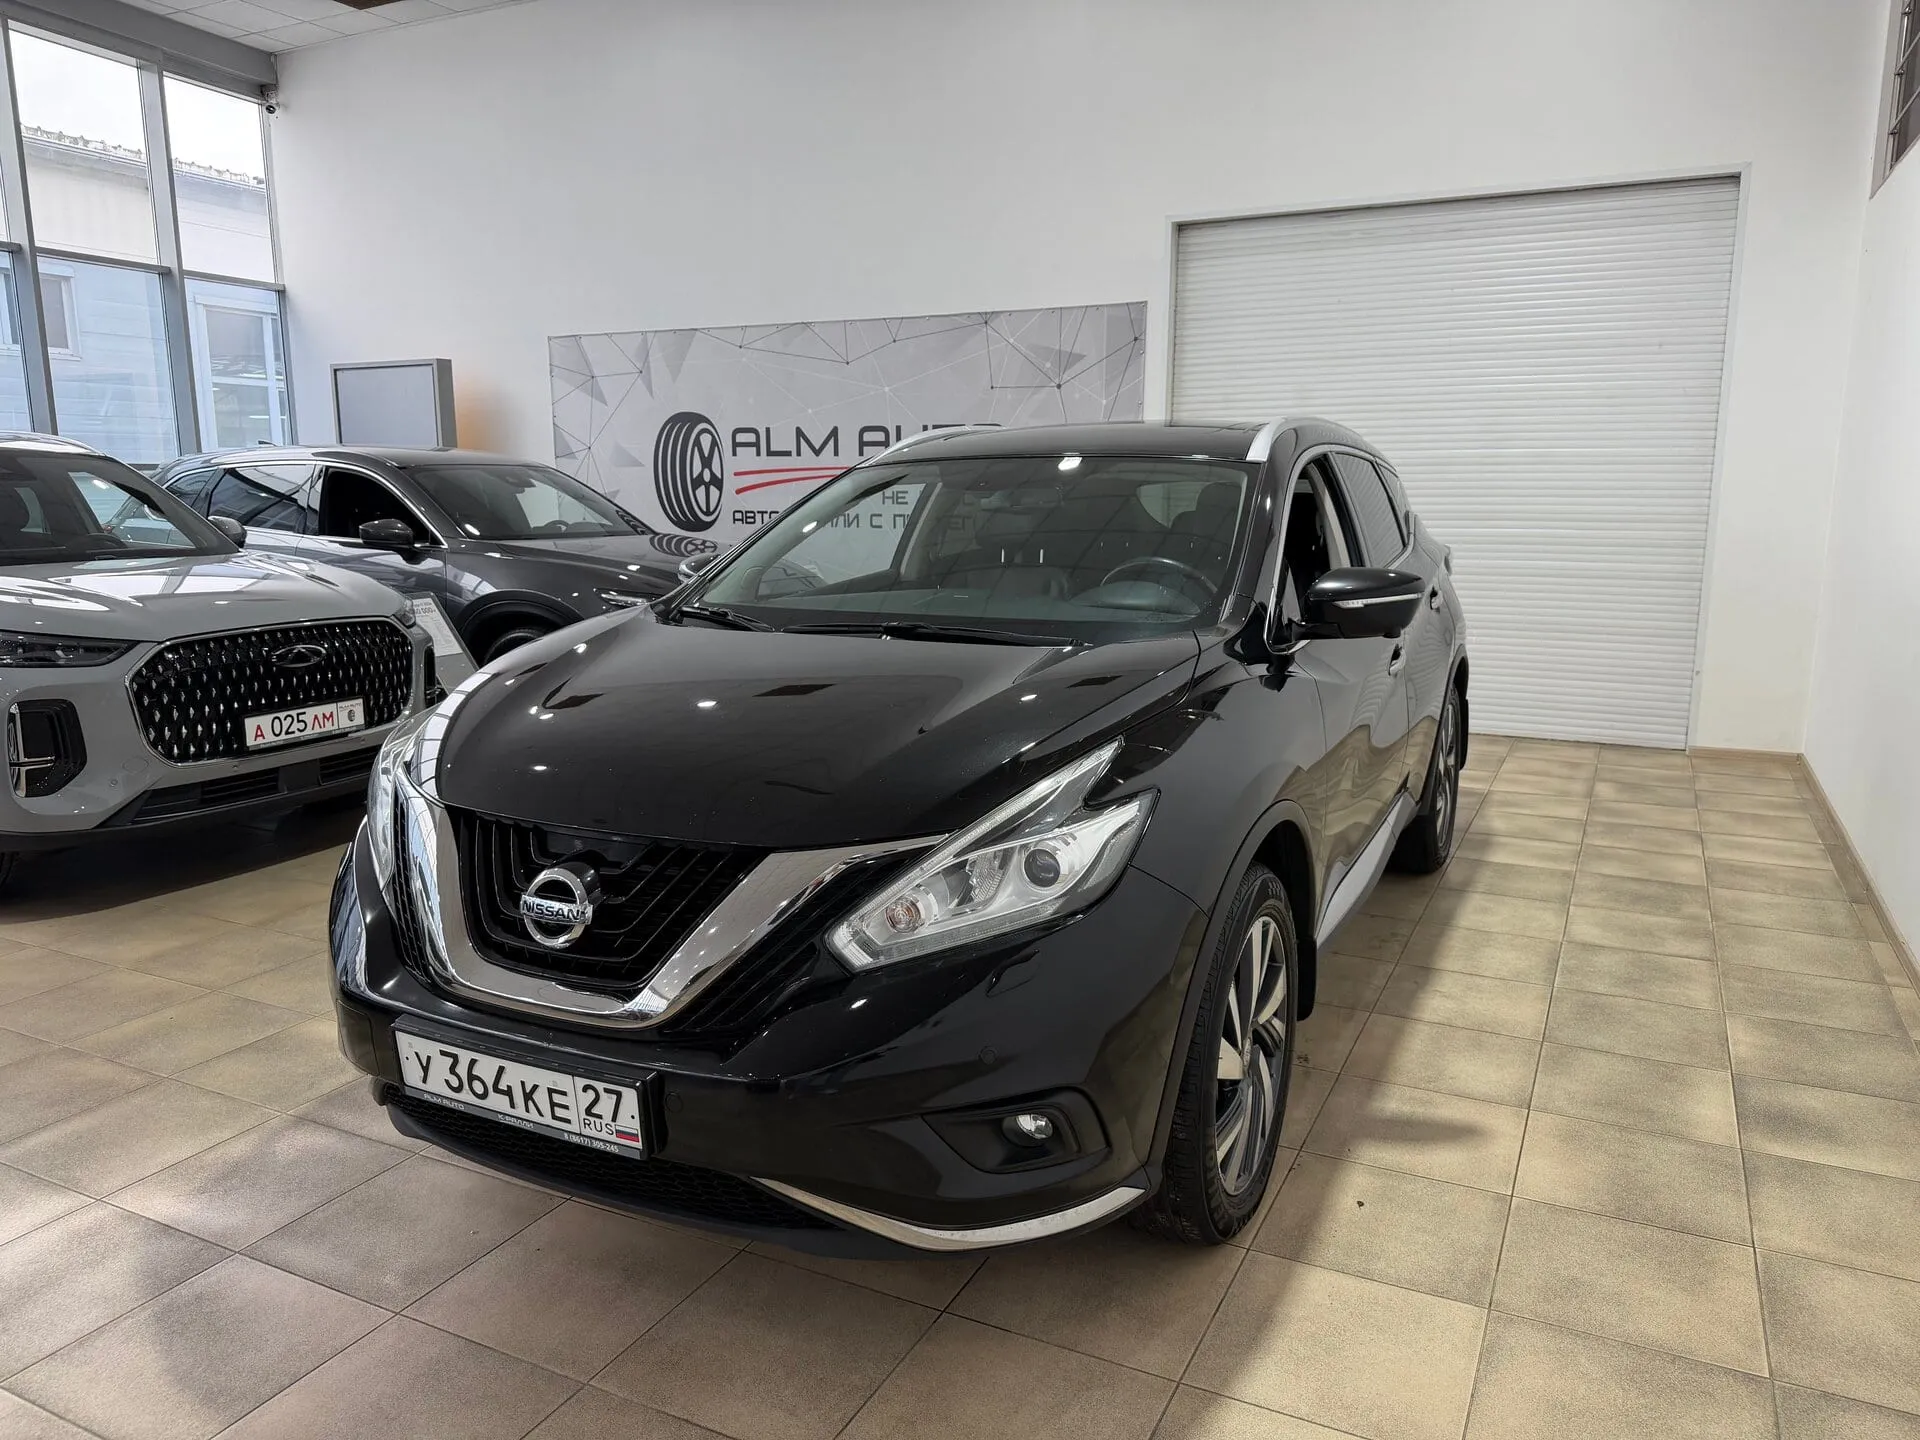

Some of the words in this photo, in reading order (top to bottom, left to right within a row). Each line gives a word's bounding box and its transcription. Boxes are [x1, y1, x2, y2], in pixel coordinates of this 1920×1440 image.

[731, 426, 839, 457] ALM
[522, 900, 582, 920] NISSAN
[581, 1083, 623, 1123] 27
[583, 1117, 615, 1136] RUS
